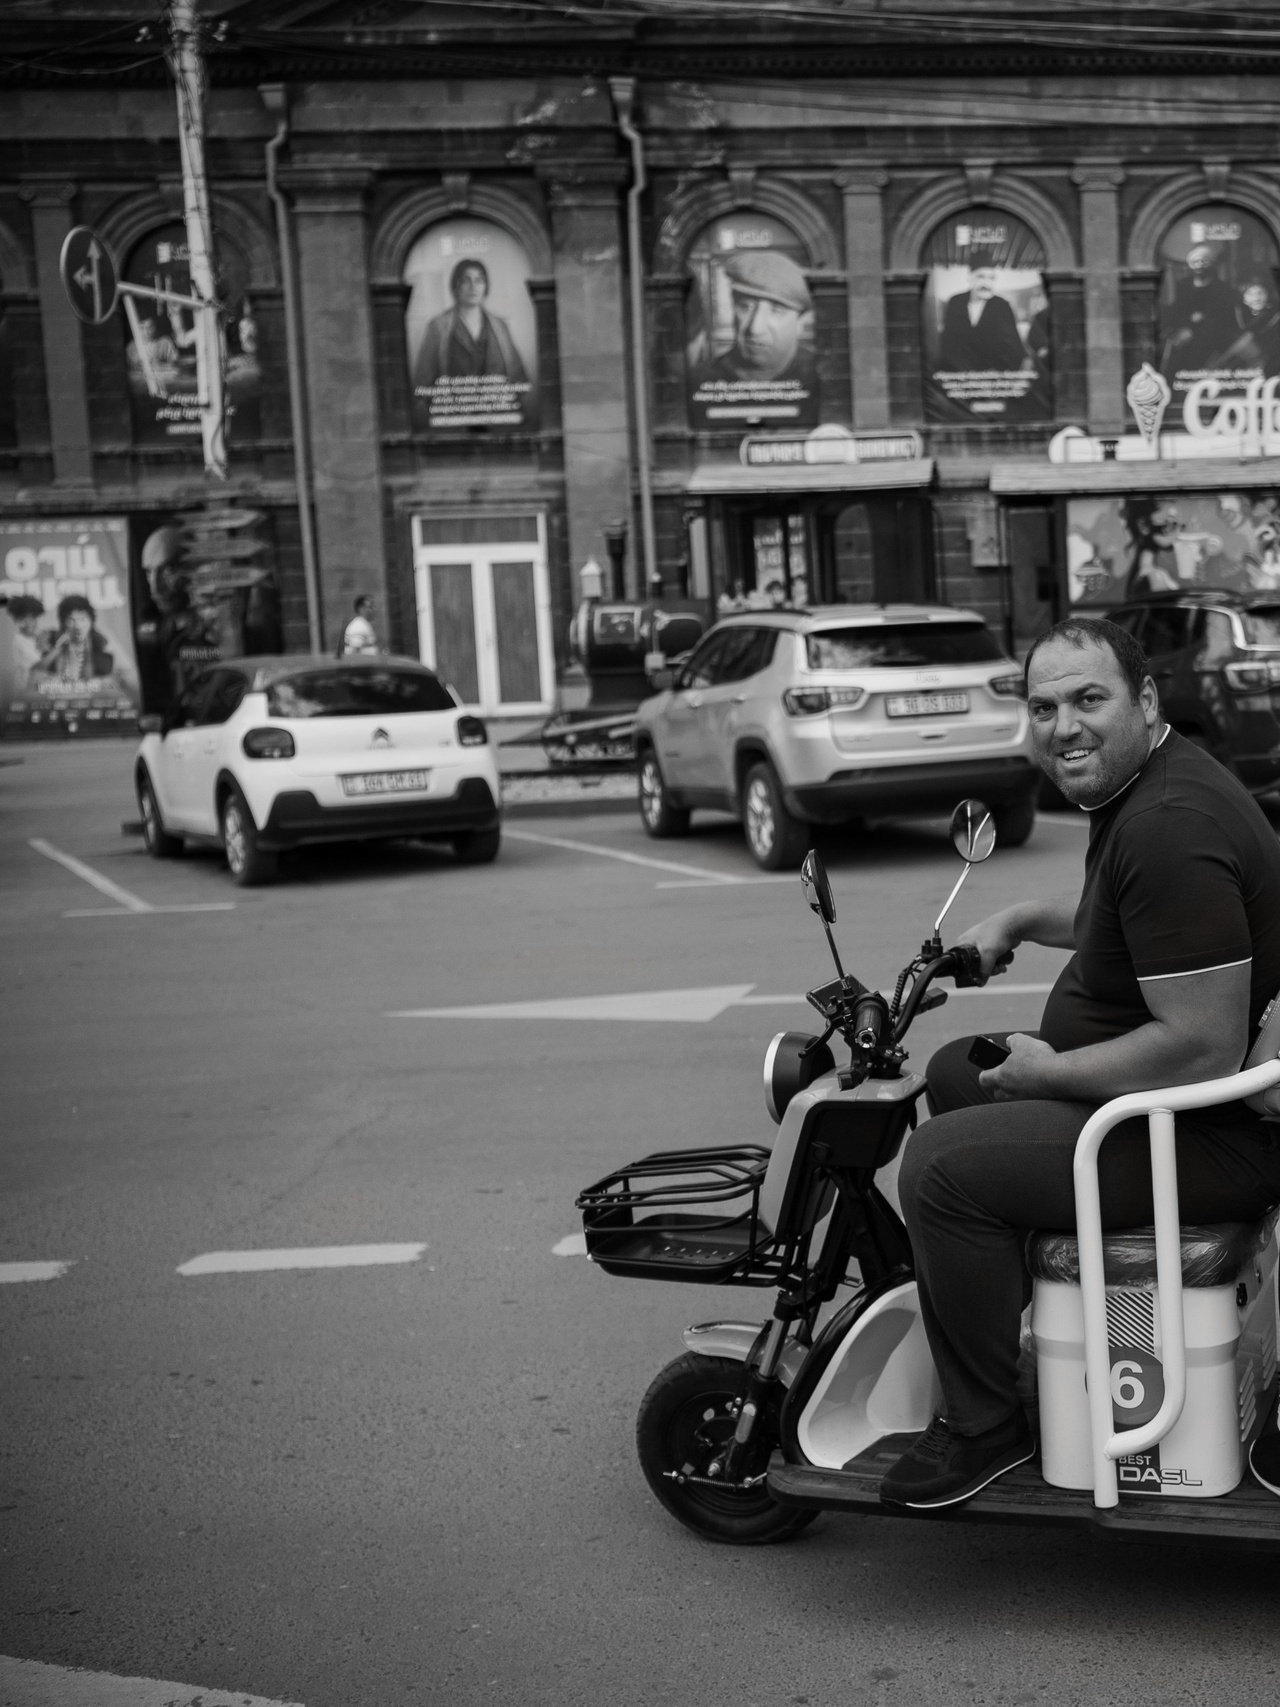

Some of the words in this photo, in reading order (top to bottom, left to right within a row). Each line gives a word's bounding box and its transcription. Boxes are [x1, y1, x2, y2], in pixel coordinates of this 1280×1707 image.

[1110, 1360, 1145, 1409] 6
[1118, 1455, 1152, 1466] BEST
[1119, 1467, 1203, 1487] DASL
